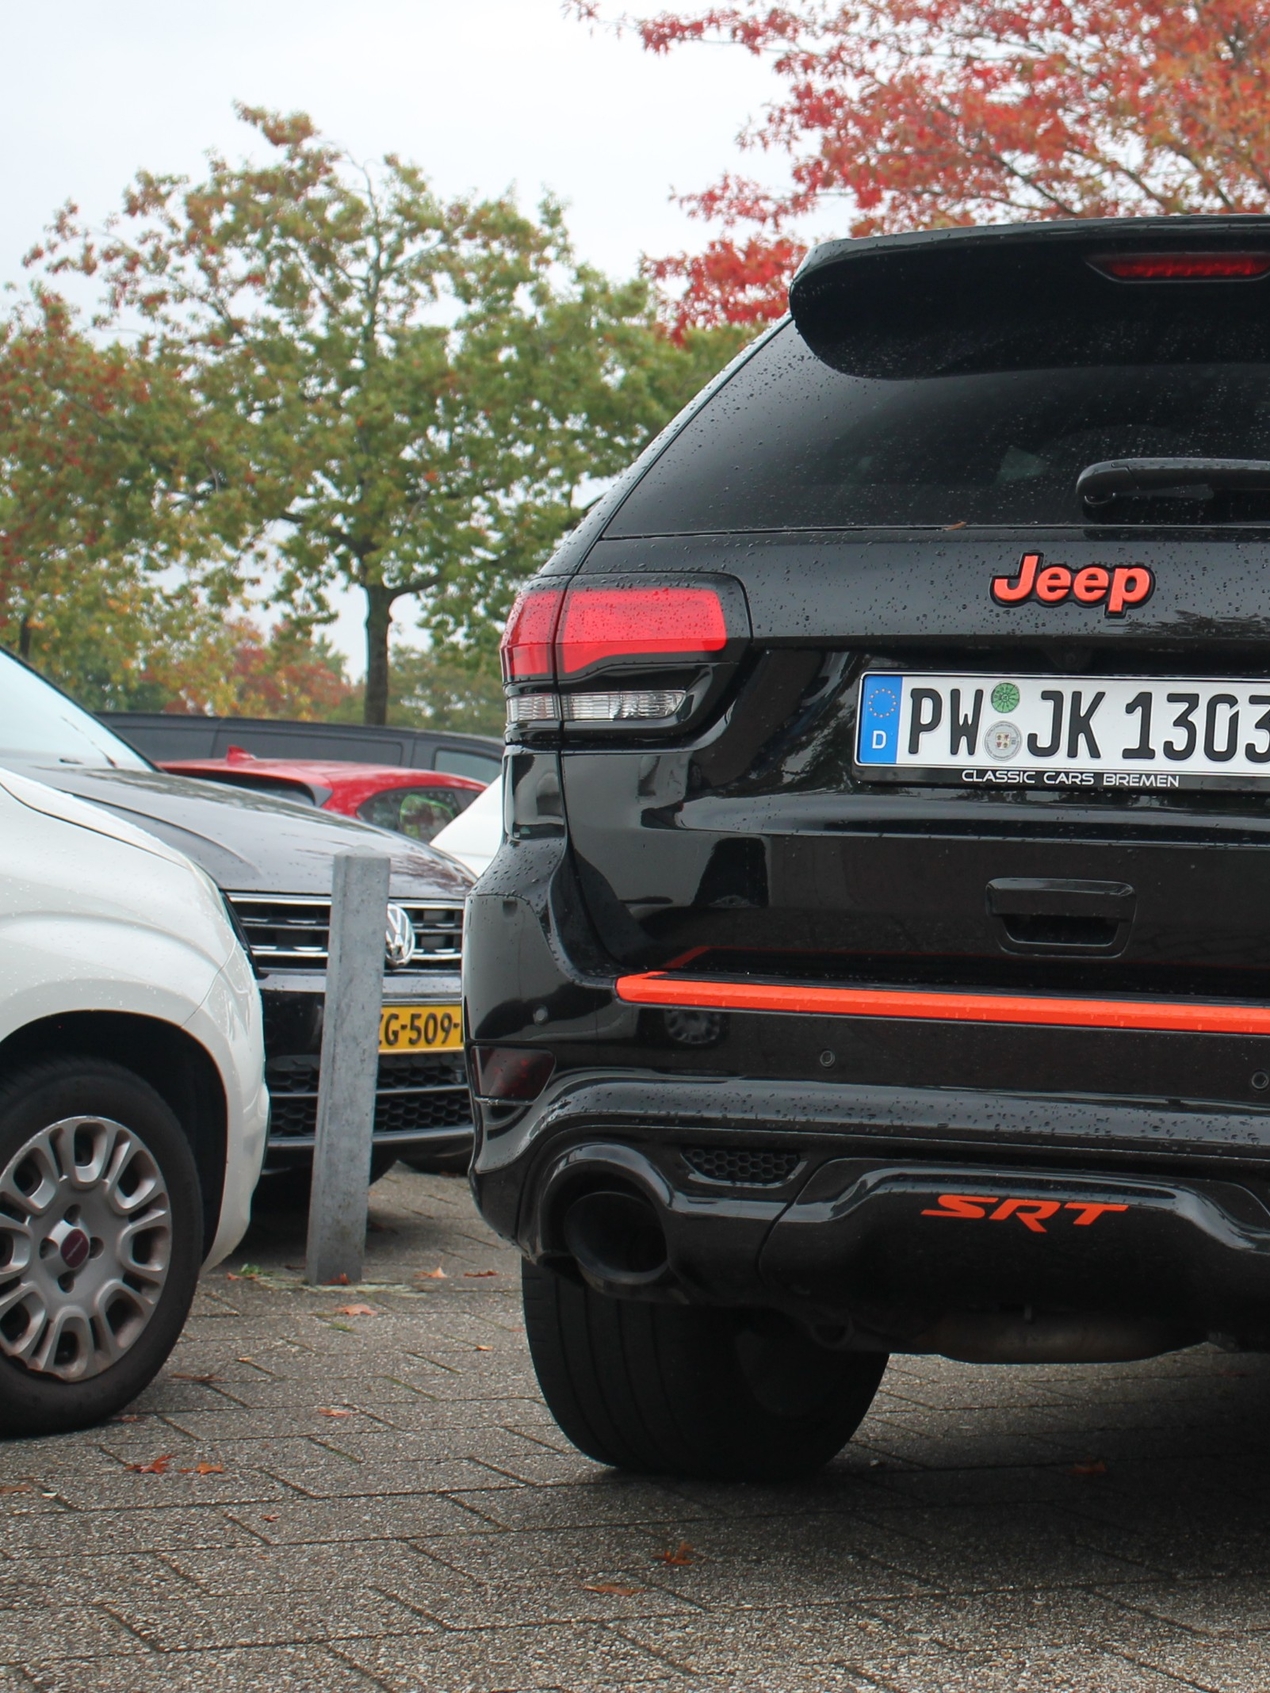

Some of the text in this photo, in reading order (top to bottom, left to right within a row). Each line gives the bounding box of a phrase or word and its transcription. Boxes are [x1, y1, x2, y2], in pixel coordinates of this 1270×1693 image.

[992, 554, 1152, 615] Jeep
[871, 730, 888, 750] D
[907, 687, 984, 757] PW
[1026, 690, 1106, 760] JK
[961, 769, 1180, 788] CLASSIC CARS BREMEN
[379, 1011, 464, 1047] G-509-
[920, 1194, 1130, 1233] SRT
